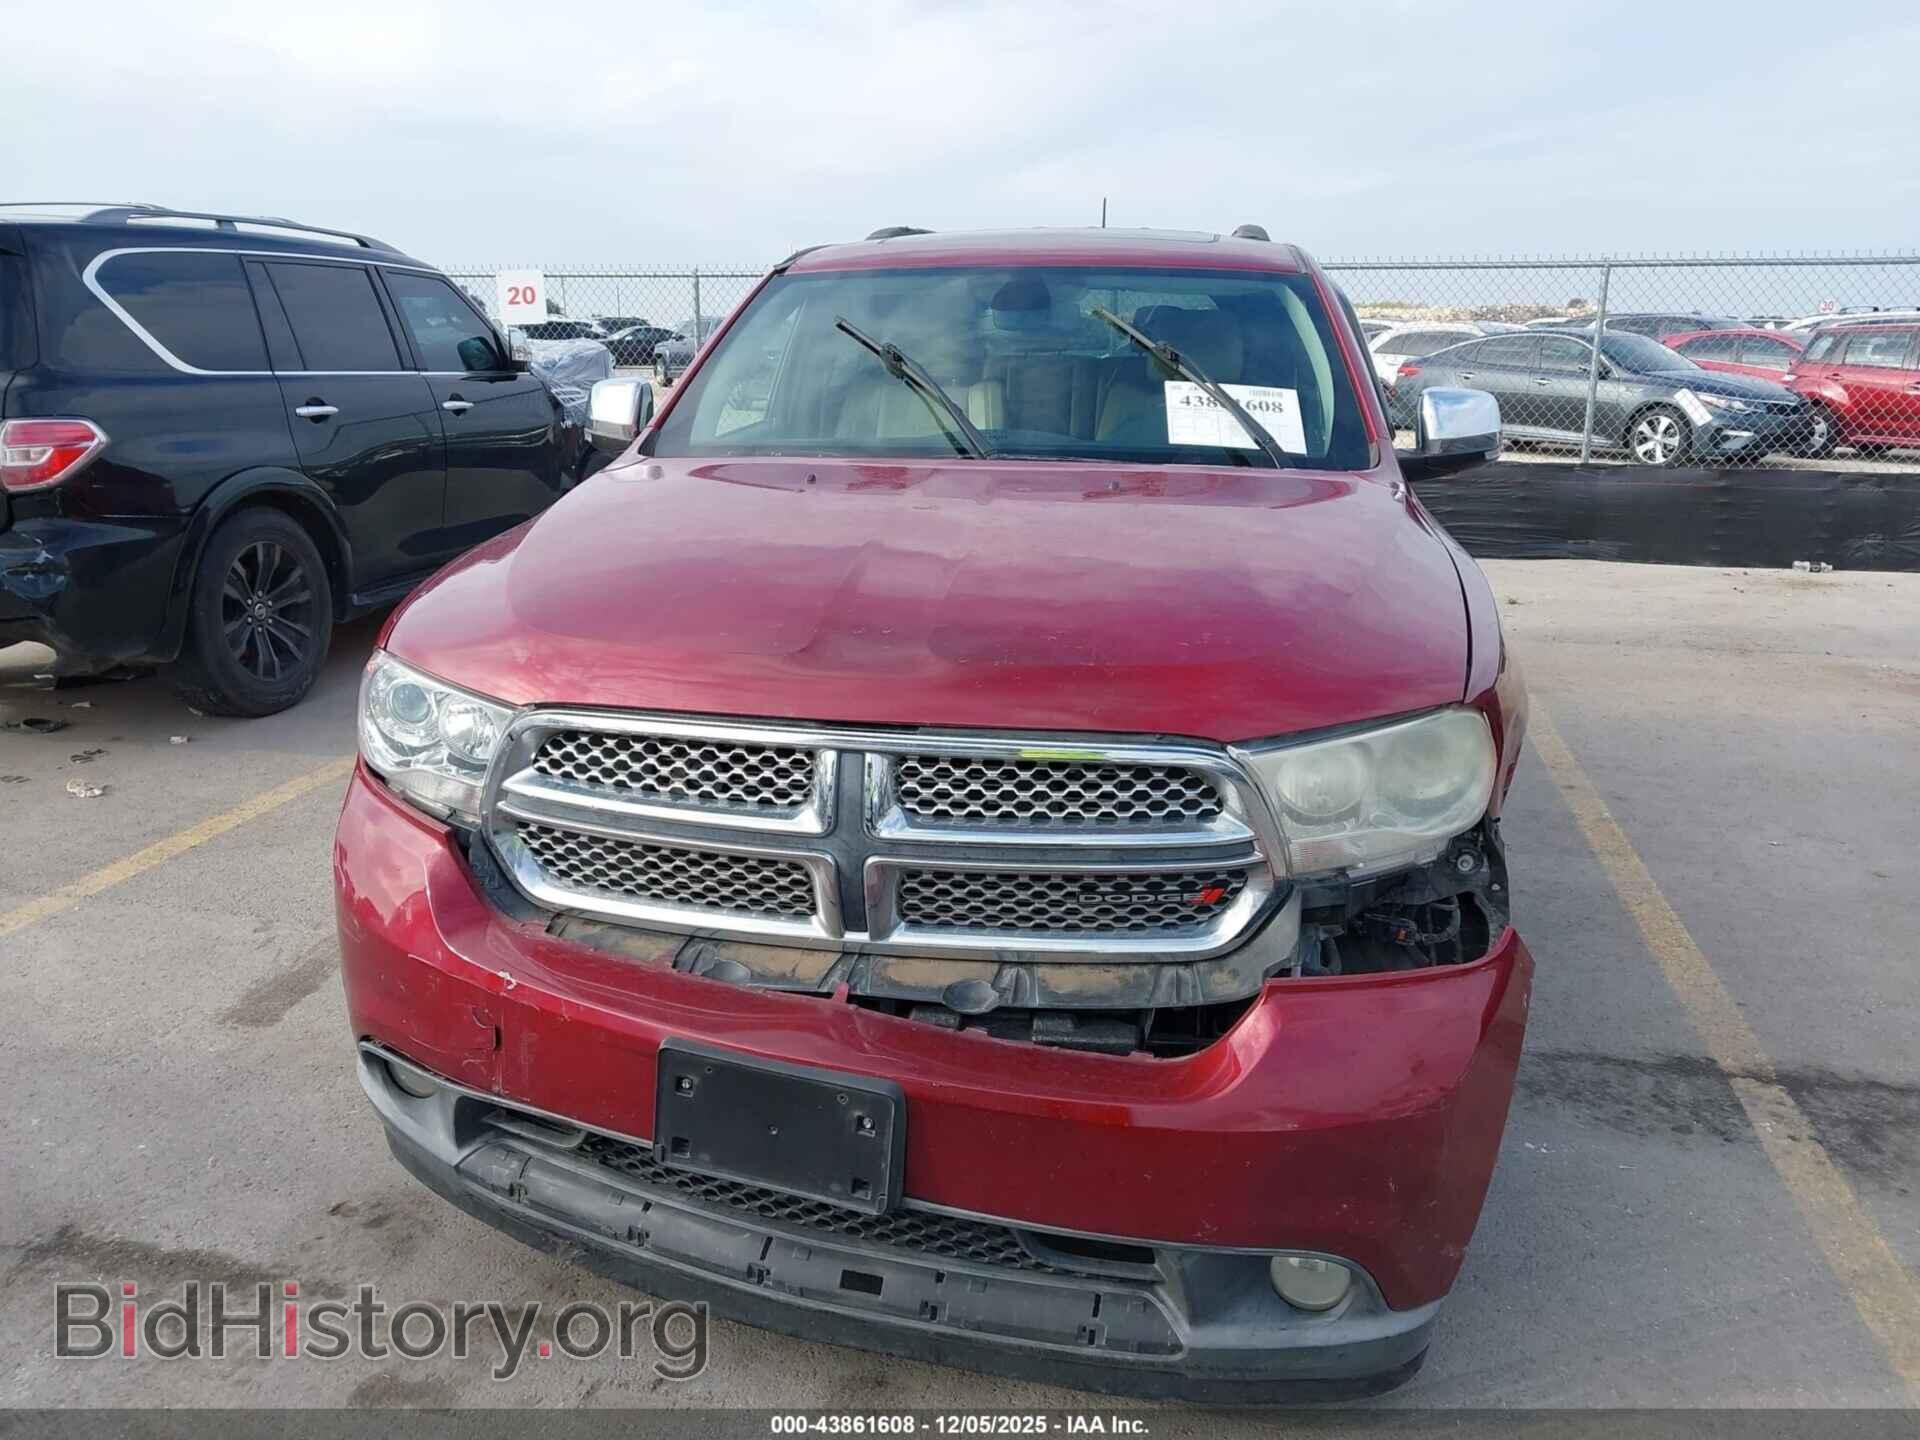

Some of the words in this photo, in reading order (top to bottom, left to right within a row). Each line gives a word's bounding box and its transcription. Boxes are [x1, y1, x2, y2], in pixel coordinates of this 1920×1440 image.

[507, 287, 535, 305] 20
[1178, 394, 1285, 414] 438608
[1079, 894, 1201, 904] DODGE
